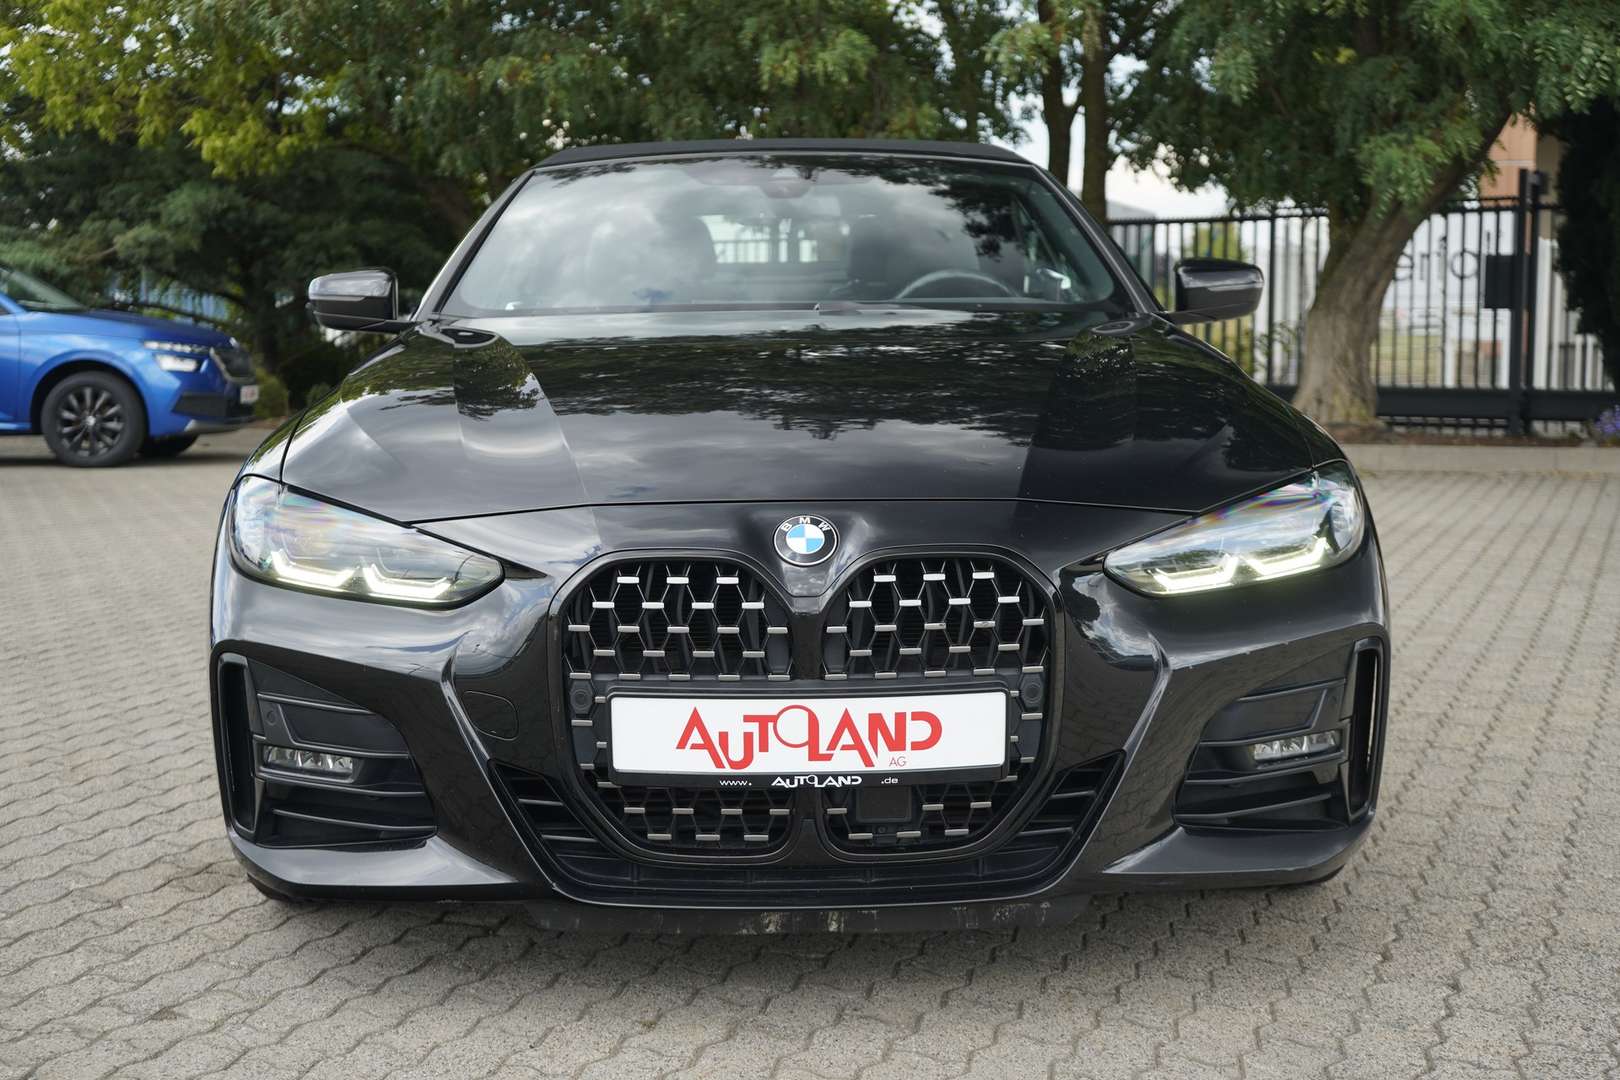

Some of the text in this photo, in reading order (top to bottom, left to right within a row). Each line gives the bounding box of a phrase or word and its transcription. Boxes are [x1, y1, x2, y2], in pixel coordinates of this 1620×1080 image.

[780, 517, 831, 532] BMW
[676, 704, 942, 770] AUTOLAND
[888, 755, 907, 768] AG
[881, 777, 899, 785] .de
